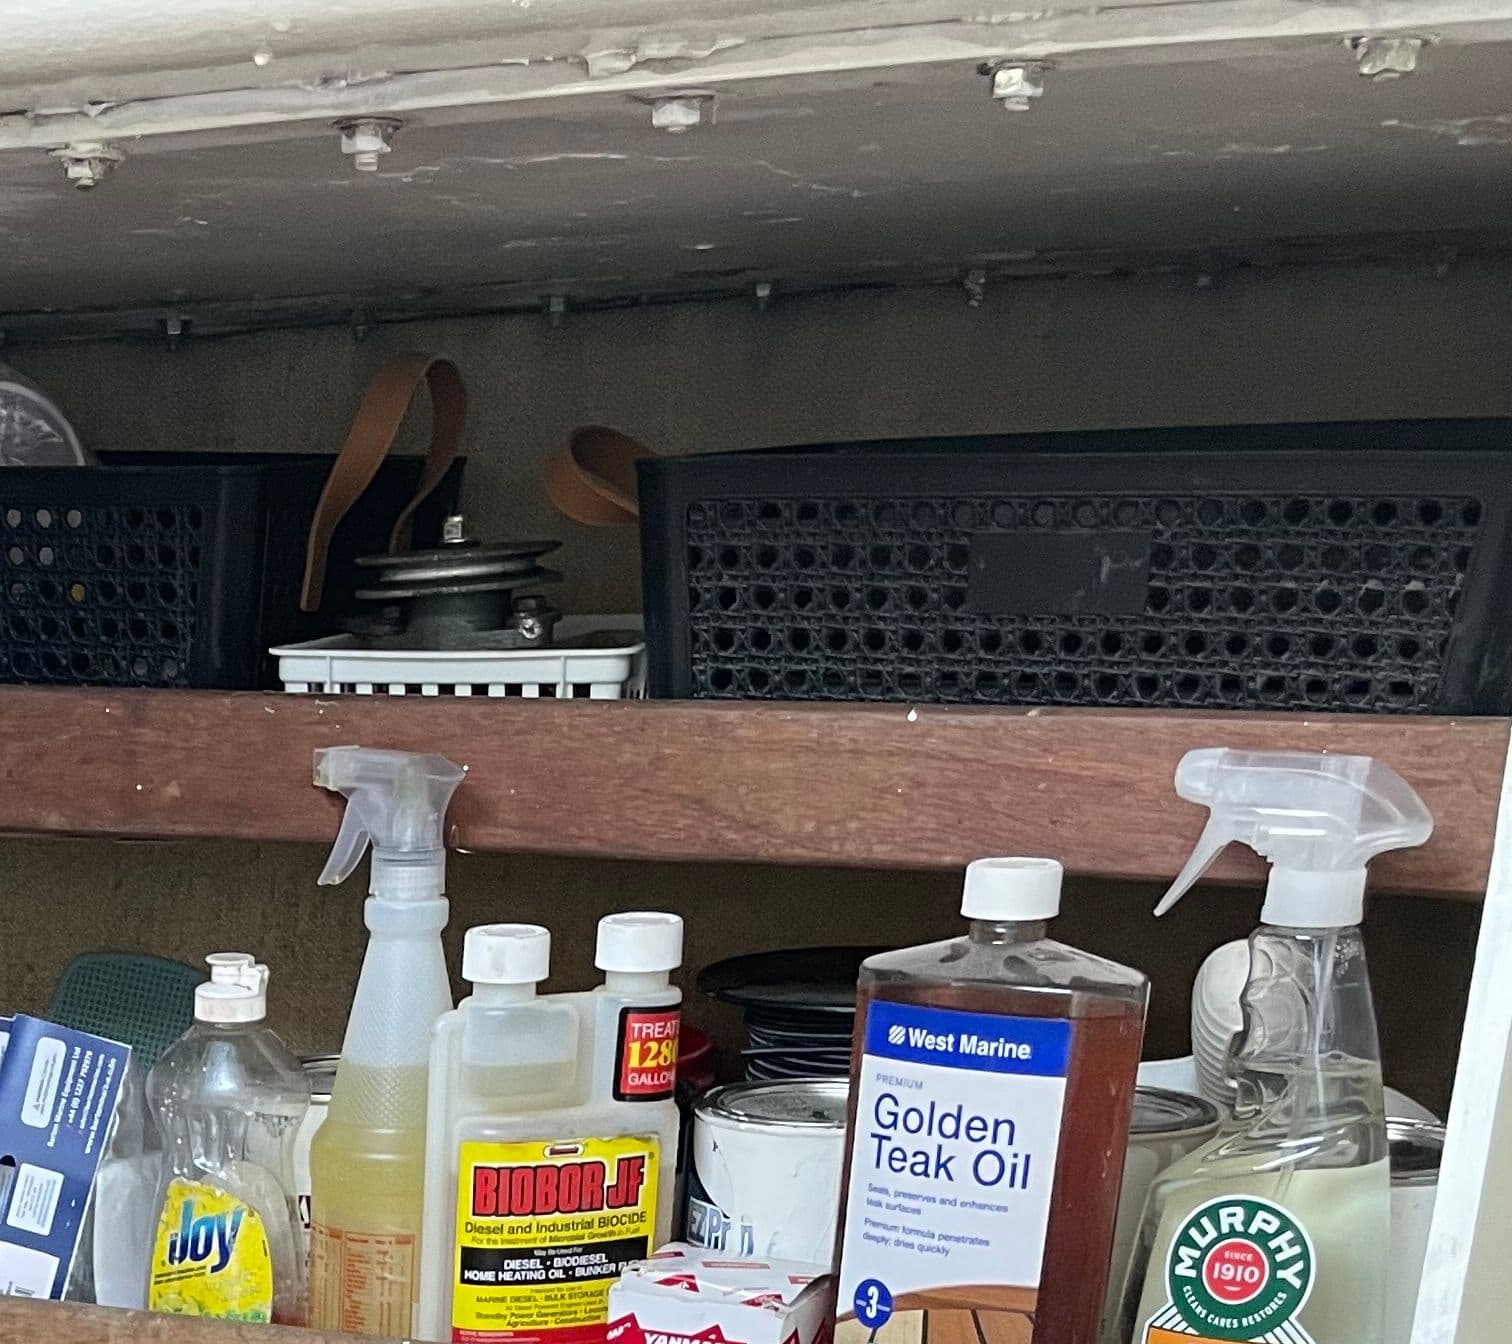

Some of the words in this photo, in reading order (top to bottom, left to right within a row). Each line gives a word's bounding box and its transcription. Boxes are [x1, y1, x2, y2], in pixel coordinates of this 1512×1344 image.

[908, 1027, 955, 1052] West
[959, 1034, 1031, 1060] Marine
[875, 1073, 924, 1090] PREMIUM
[874, 1093, 1016, 1146] Golden
[870, 1132, 957, 1182] Teak
[972, 1150, 1031, 1189] Oil
[472, 1161, 606, 1217] BIOBOR
[606, 1155, 647, 1210] JF
[939, 1196, 957, 1207] and
[465, 1221, 504, 1235] Diesel
[508, 1221, 532, 1234] and
[536, 1218, 595, 1234] Industrial
[598, 1211, 647, 1227] BIOCIDE
[168, 1200, 246, 1274] Joy
[1175, 1206, 1304, 1289] MURPHY
[918, 1243, 950, 1256] quickly
[1224, 1250, 1254, 1262] SINCE
[464, 1269, 496, 1282] HOME
[498, 1268, 546, 1282] HEATING
[548, 1268, 566, 1280] OIL
[575, 1262, 616, 1278] BUNKER
[504, 1258, 544, 1270] DIESEL
[553, 1254, 608, 1268] BIODIESEL
[1213, 1262, 1260, 1284] 1910
[865, 1285, 880, 1320] 3
[1183, 1285, 1208, 1318] CLEANS
[1208, 1314, 1238, 1328] CARES
[1242, 1292, 1288, 1327] RESTORES
[510, 1310, 534, 1320] Power
